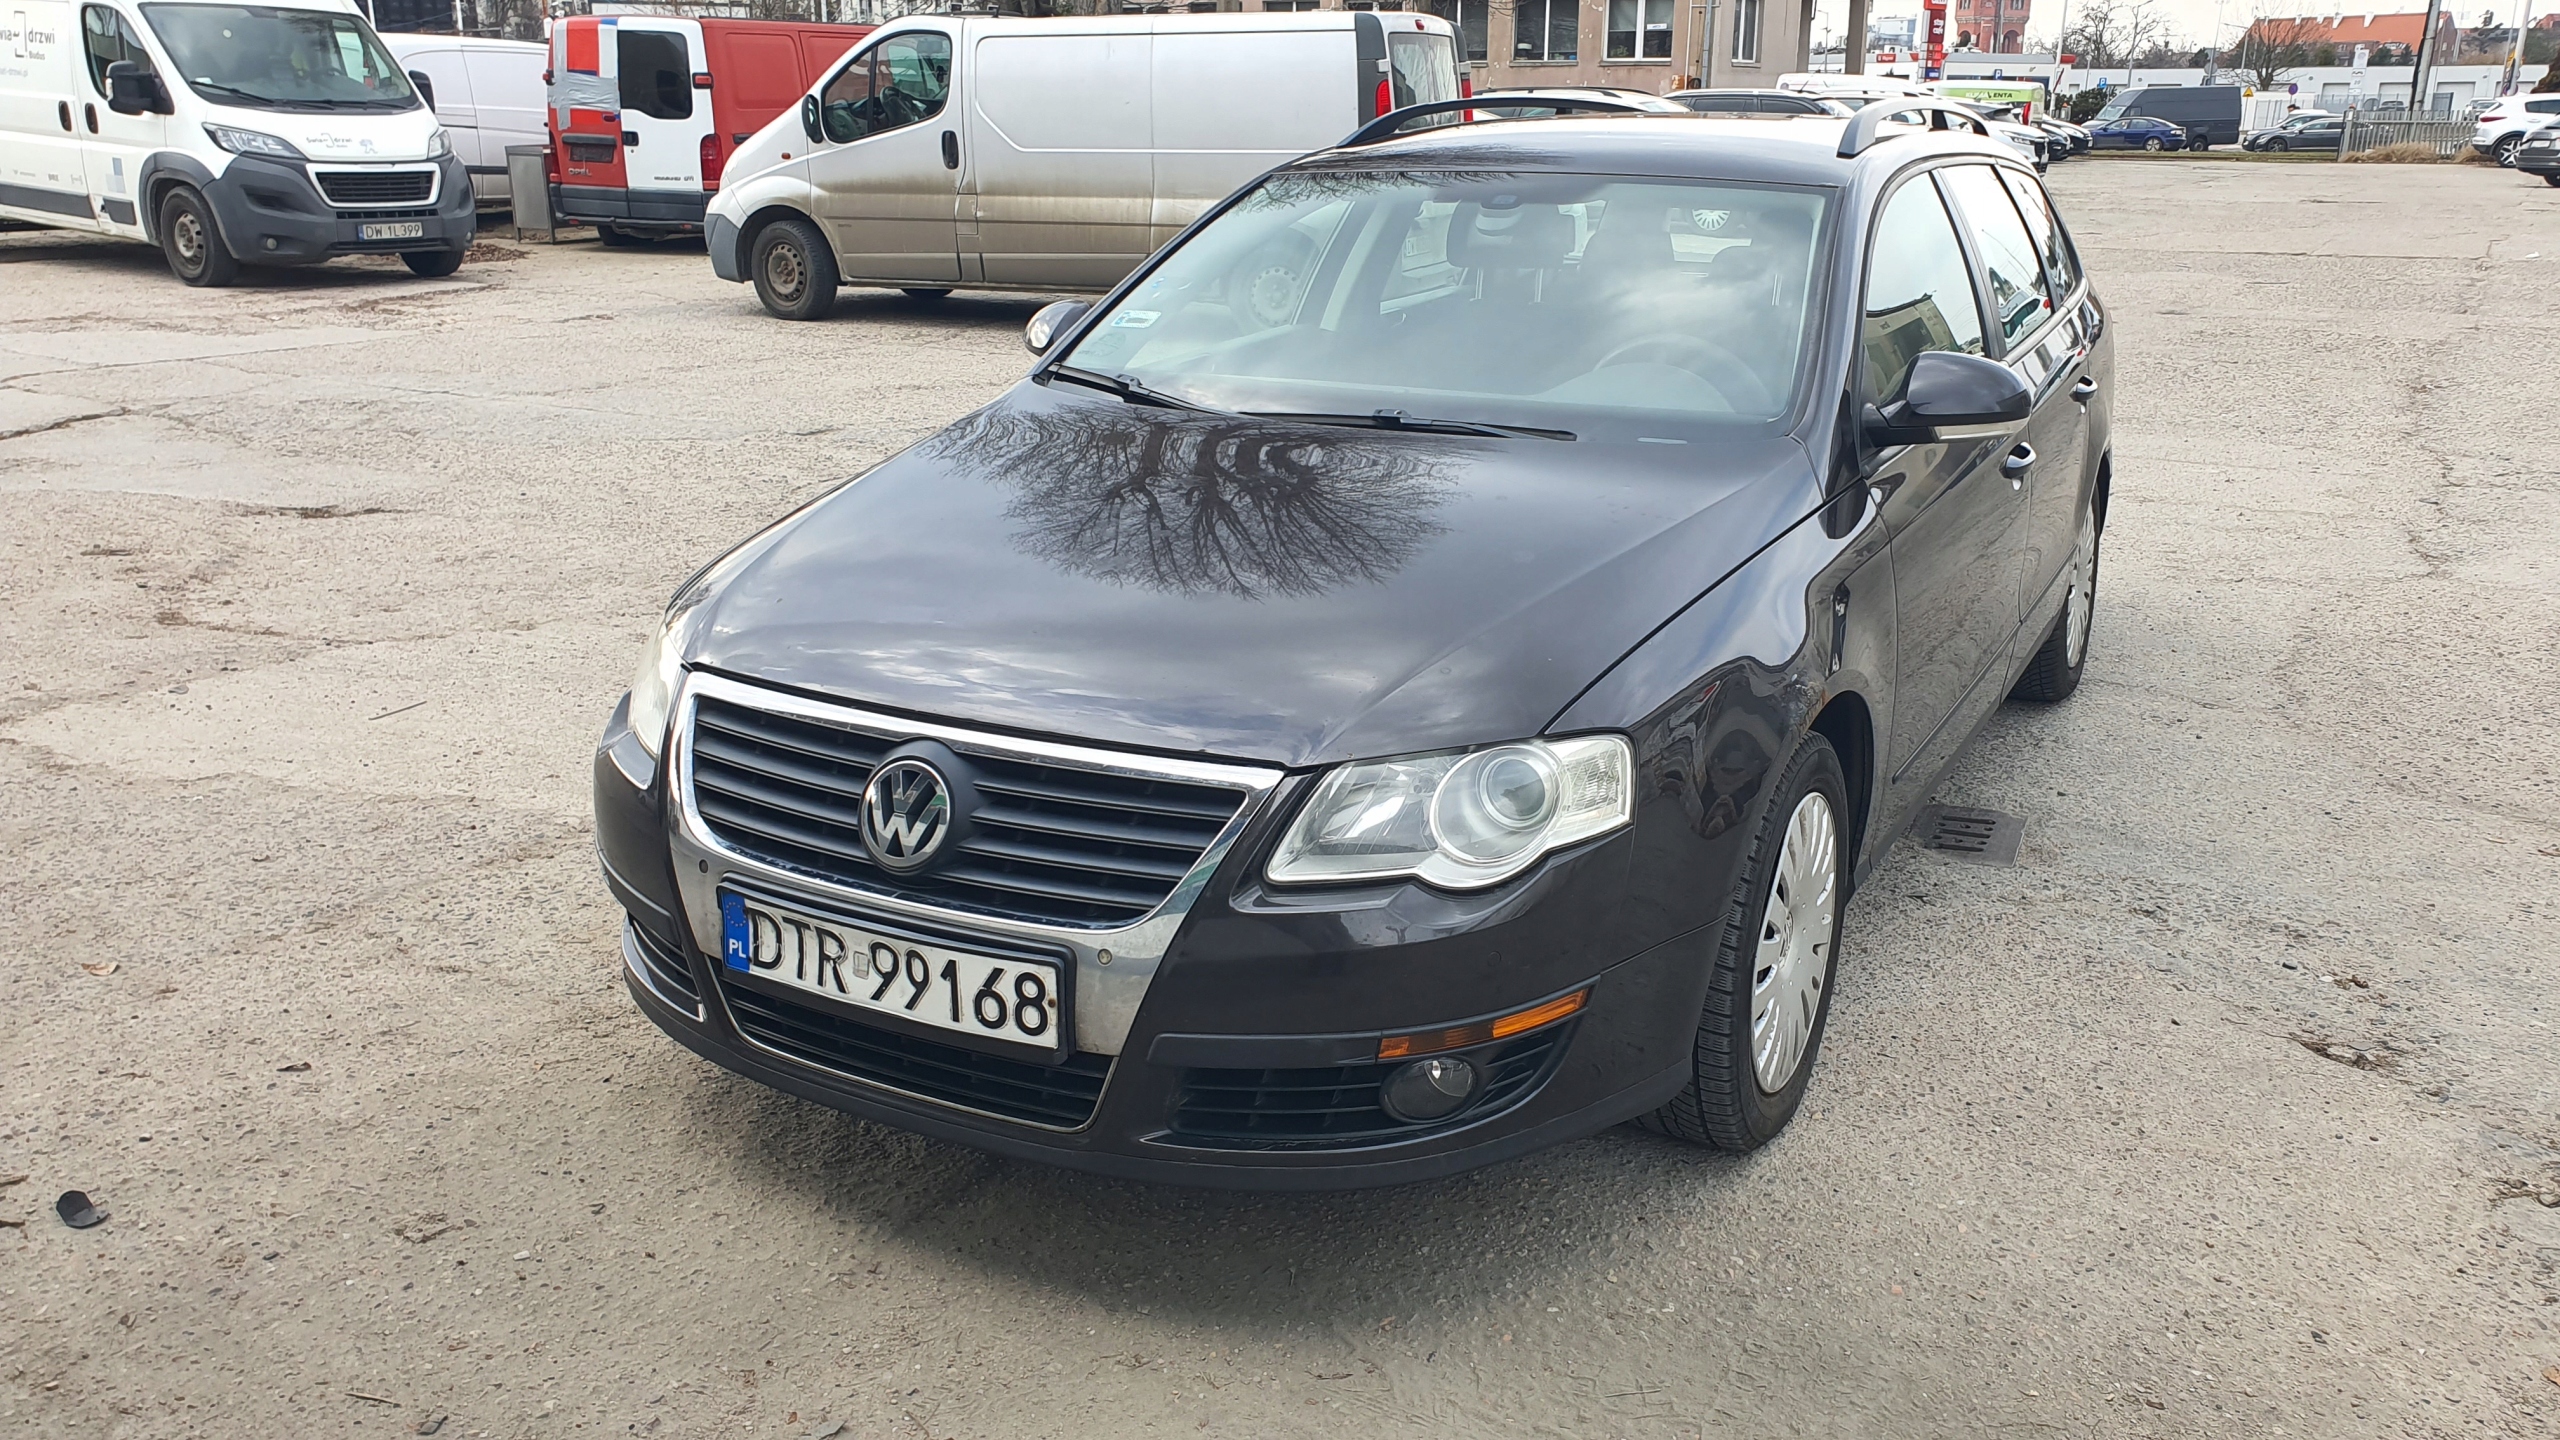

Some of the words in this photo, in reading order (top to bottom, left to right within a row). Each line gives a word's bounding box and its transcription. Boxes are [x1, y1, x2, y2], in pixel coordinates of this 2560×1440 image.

[28, 26, 55, 45] drzwi
[568, 167, 592, 177] OPEL
[365, 225, 383, 239] DW
[388, 224, 420, 237] 1L399
[728, 938, 747, 959] PL
[751, 908, 850, 995] DTR
[868, 938, 1050, 1038] 99168
